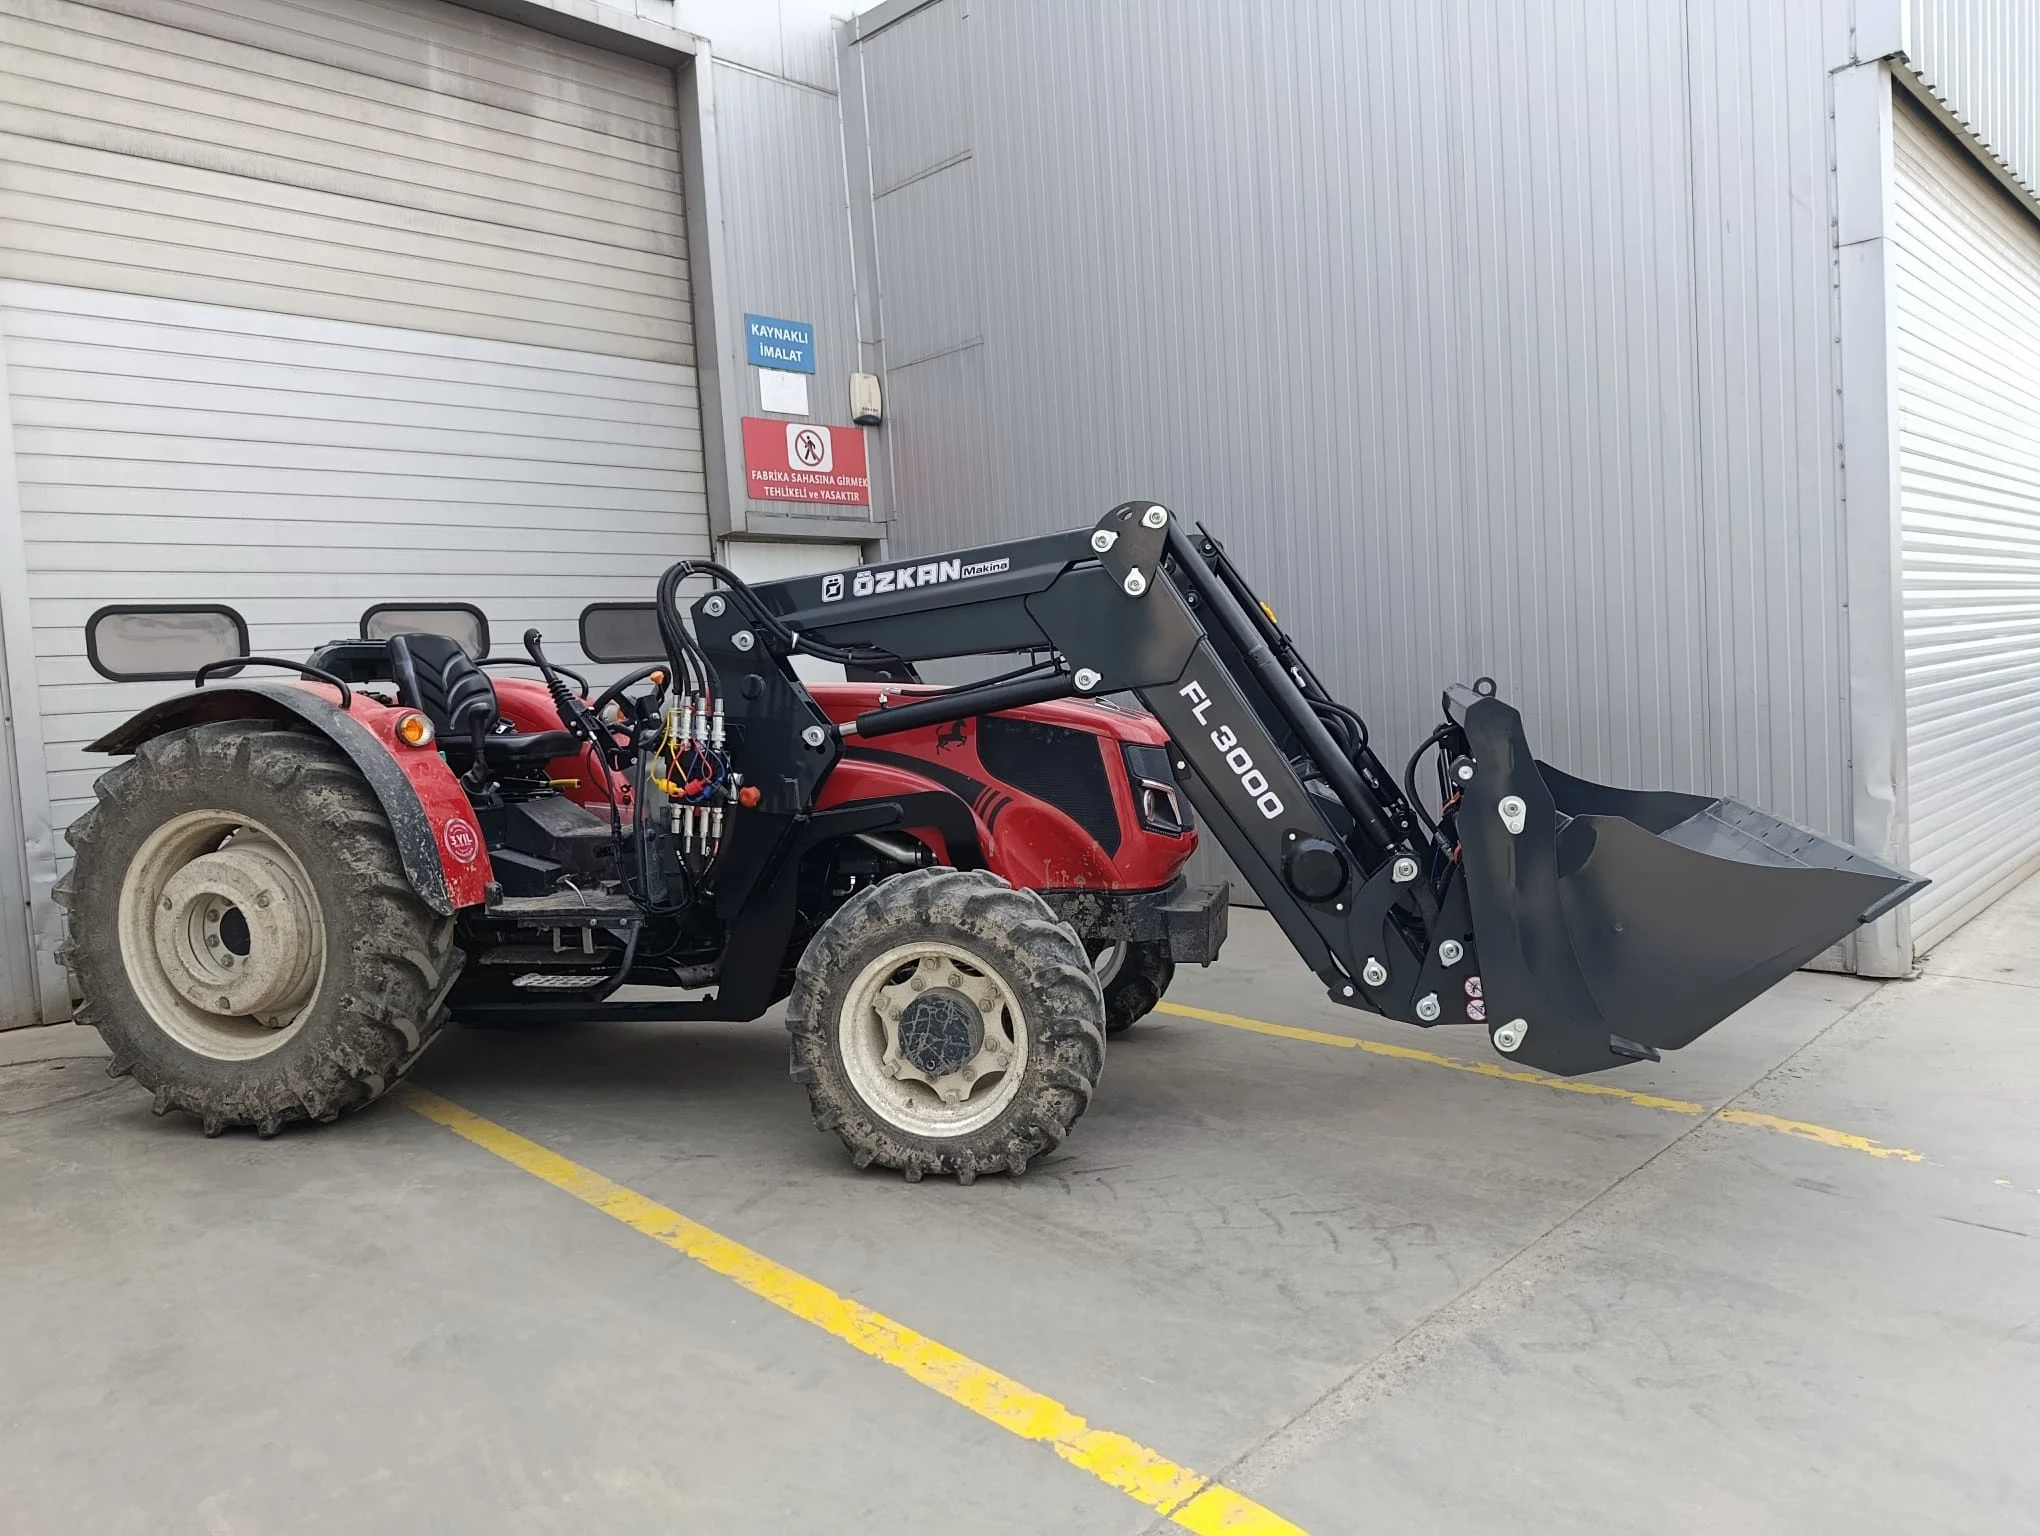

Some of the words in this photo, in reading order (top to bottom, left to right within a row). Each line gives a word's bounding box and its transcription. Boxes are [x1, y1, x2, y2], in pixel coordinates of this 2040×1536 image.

[751, 323, 809, 344] KAYNAKLI
[759, 342, 803, 362] İMALAT
[751, 469, 790, 483] FABRİKA
[791, 472, 836, 486] SAHASINA
[837, 474, 869, 488] GİRMEK
[763, 485, 807, 499] TEHLİKELİ
[808, 490, 819, 499] ve
[820, 489, 860, 501] YASAKTIR
[853, 559, 961, 597] ÖZKAN
[962, 560, 1008, 577] Makina
[1179, 680, 1213, 726] FL
[1210, 724, 1285, 820] 3000
